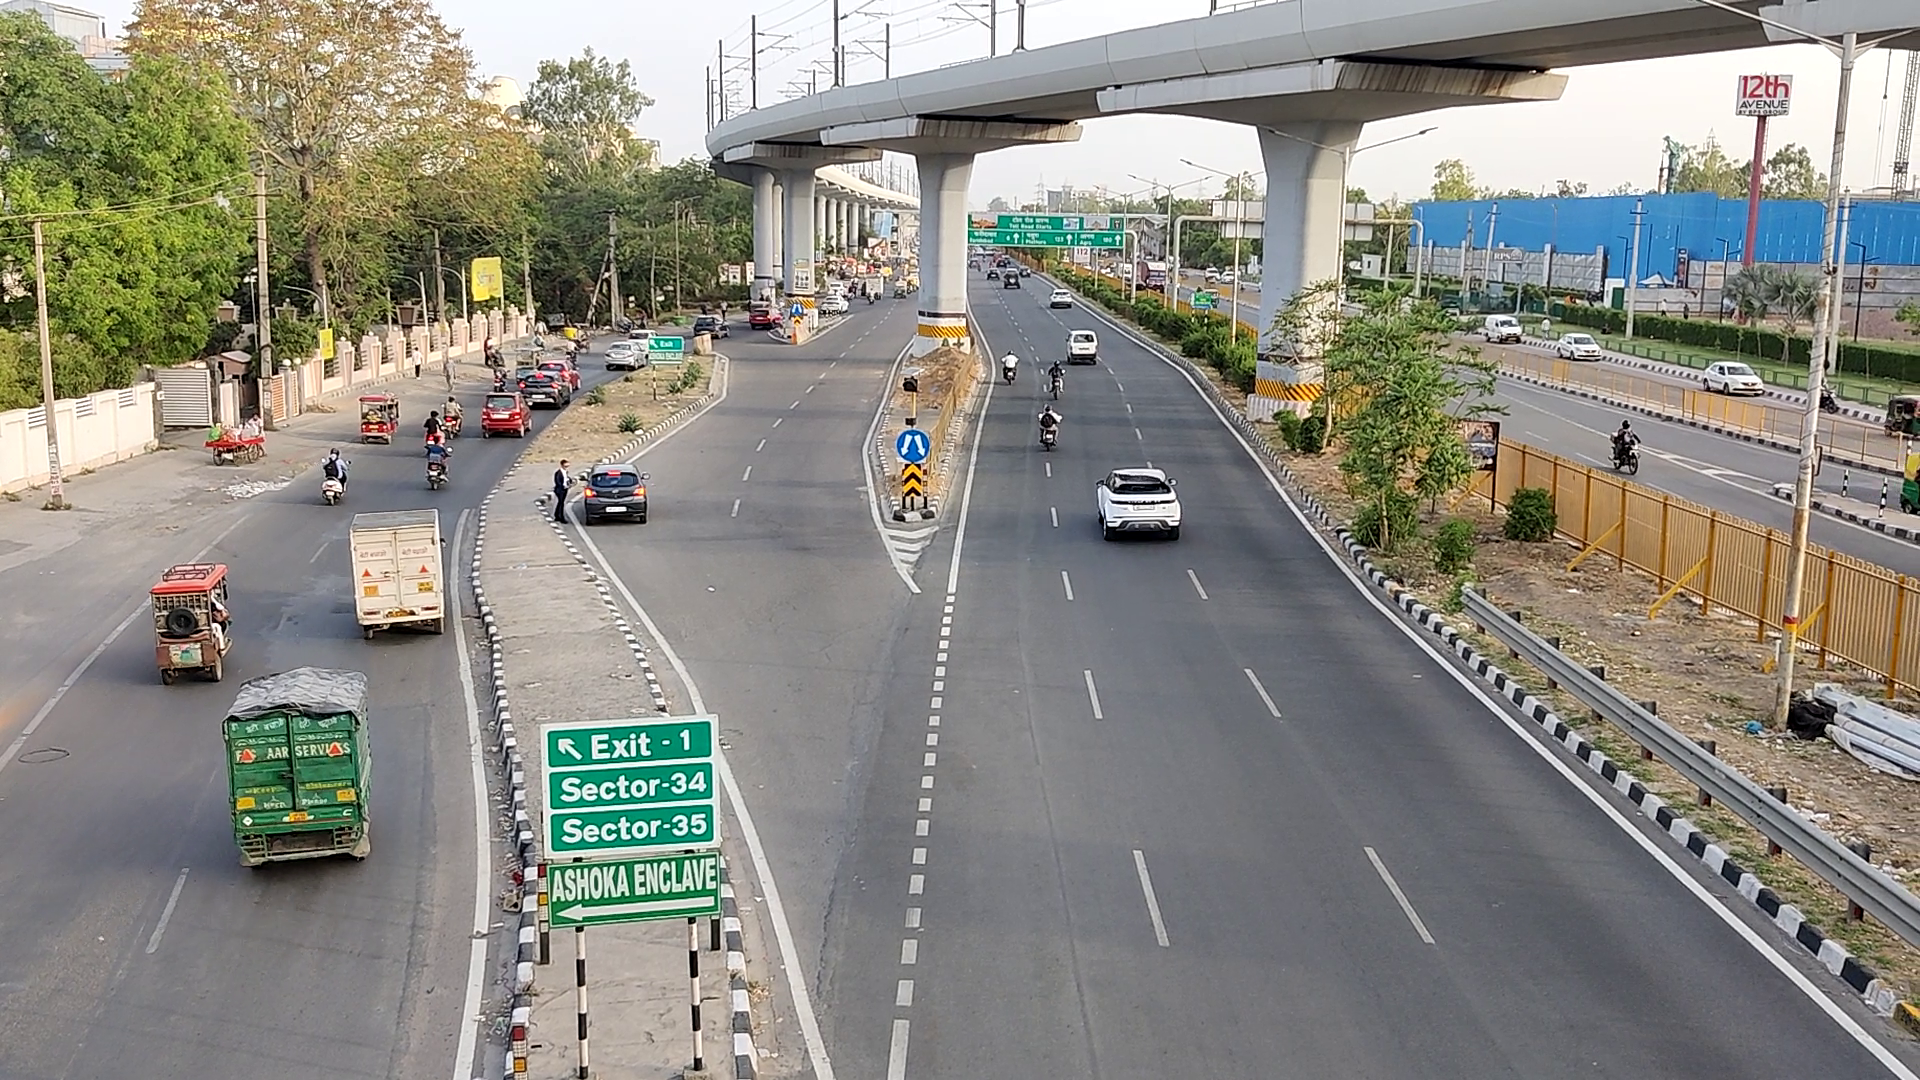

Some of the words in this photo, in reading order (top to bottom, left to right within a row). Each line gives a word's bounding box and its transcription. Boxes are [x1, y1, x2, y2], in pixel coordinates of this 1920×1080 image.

[1742, 75, 1789, 98] 12th
[1740, 100, 1788, 109] AVENUE
[267, 746, 289, 760] AAR
[294, 742, 351, 757] SERVIS
[591, 732, 651, 760] Exit
[679, 729, 690, 750] 1
[560, 771, 707, 803] Sector-34
[561, 813, 707, 844] Sector-35
[552, 865, 630, 902] ASHOKA
[633, 857, 717, 896] ENCLAVE
